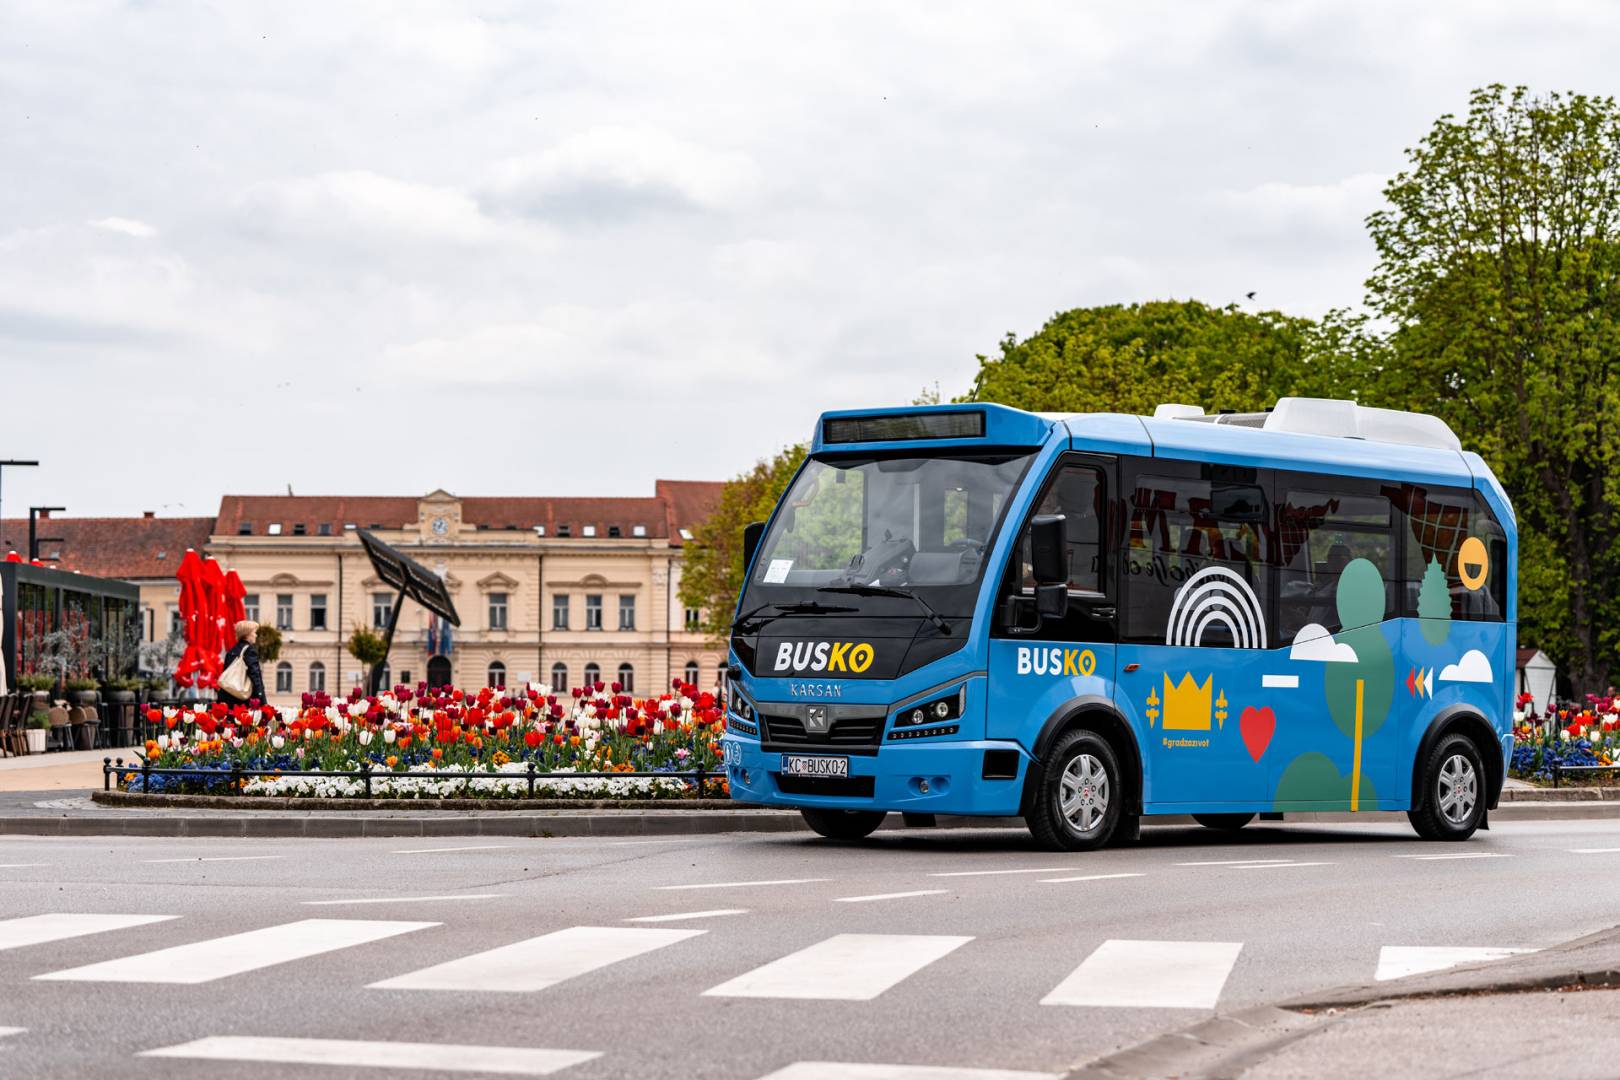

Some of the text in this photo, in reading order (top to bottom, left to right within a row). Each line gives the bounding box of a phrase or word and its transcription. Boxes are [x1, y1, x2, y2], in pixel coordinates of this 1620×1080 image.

[774, 641, 875, 673] BUSKO
[1016, 647, 1097, 677] BUSKO
[791, 683, 842, 697] KARSAN
[789, 758, 801, 773] KC
